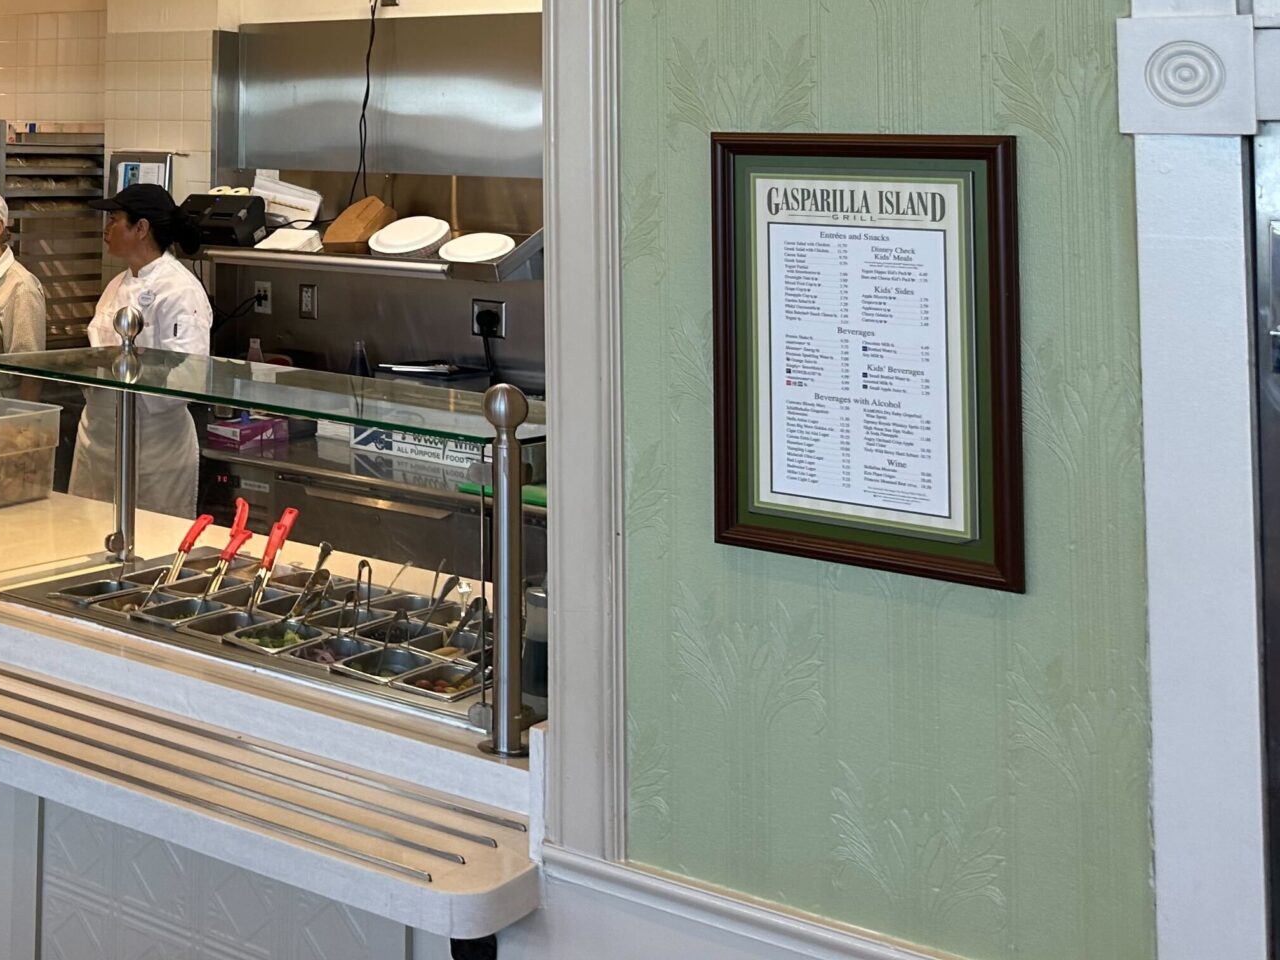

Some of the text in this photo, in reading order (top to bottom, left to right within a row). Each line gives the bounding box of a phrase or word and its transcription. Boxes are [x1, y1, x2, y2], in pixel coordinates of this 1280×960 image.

[767, 186, 945, 222] GASPARILLA ISLAND
[832, 214, 876, 222] GRILL
[820, 231, 846, 240] Entrées
[871, 246, 893, 256] Disney
[837, 326, 874, 337] Beverages
[888, 366, 924, 376] Beverages
[814, 393, 851, 404] Beverages
[871, 400, 901, 408] Alcohol
[397, 446, 440, 459] ALL PURPOSE
[446, 455, 464, 463] FOOD
[887, 459, 907, 468] Wine
